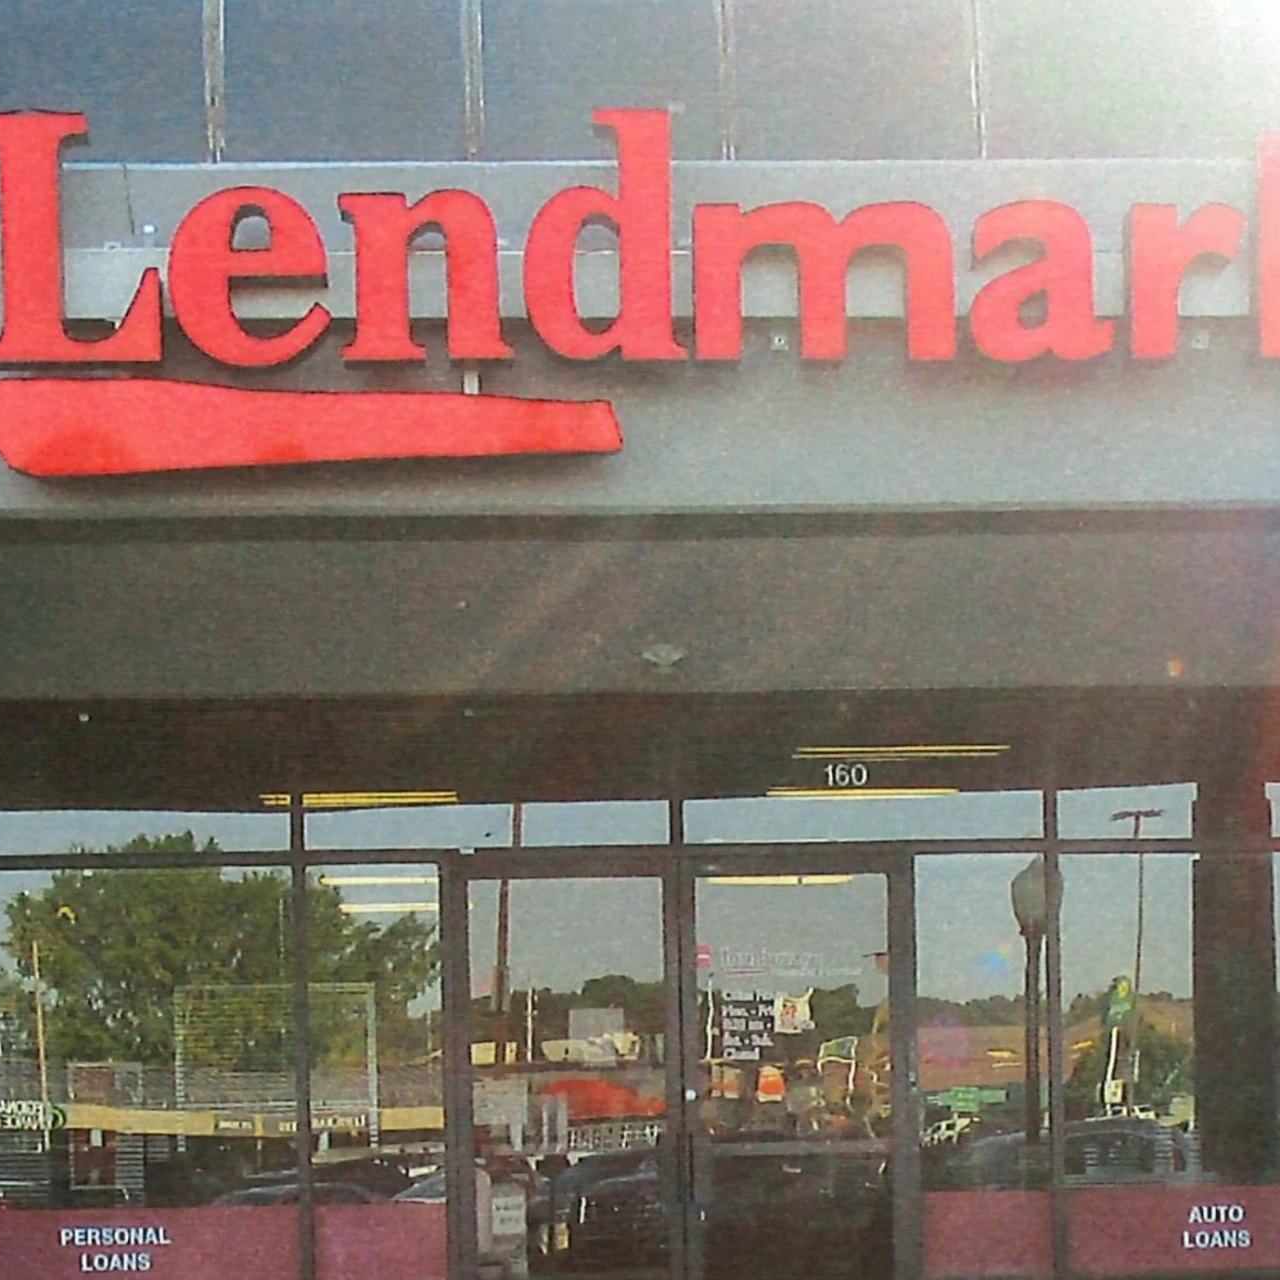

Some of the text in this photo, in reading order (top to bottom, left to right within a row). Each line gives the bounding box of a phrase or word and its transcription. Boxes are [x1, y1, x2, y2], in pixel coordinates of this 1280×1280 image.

[823, 764, 868, 786] 160
[1188, 1204, 1244, 1224] AUTO
[60, 1226, 172, 1247] PERSONAL
[1182, 1229, 1251, 1249] LOANS
[81, 1252, 151, 1272] LOANS
